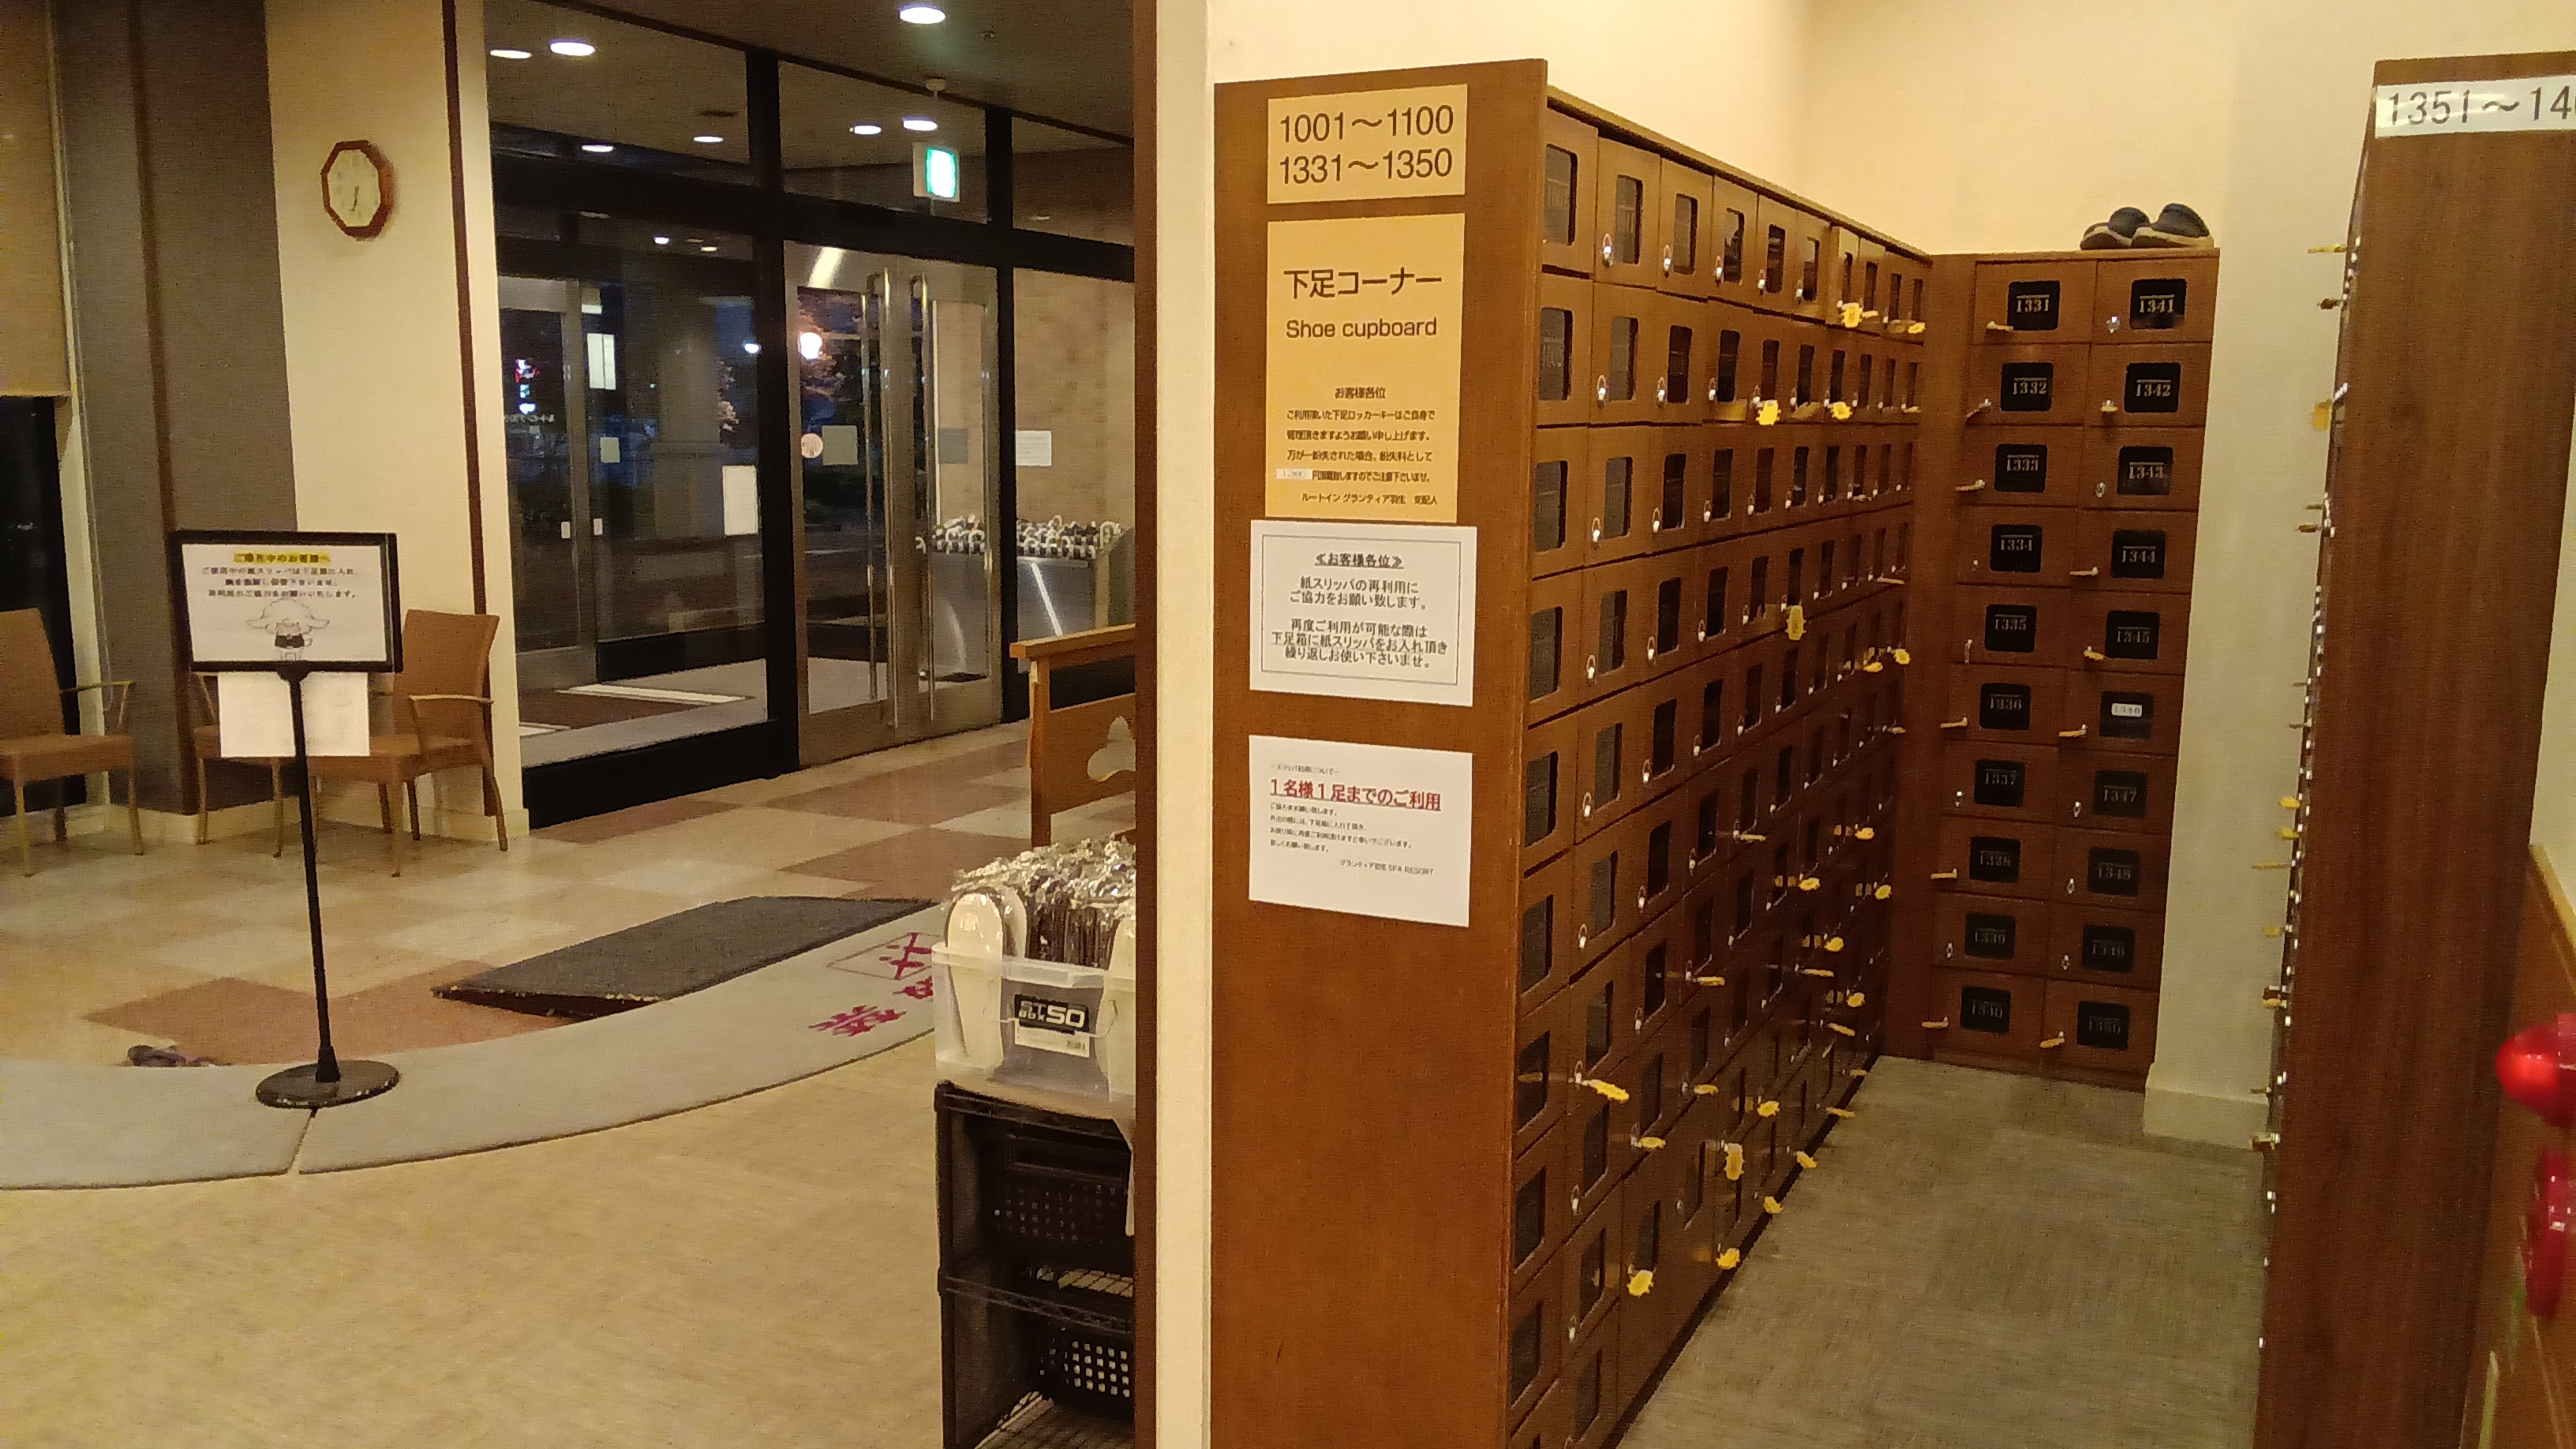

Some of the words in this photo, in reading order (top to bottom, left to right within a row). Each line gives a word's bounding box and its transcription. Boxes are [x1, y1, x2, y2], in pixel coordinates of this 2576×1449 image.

[2389, 85, 2576, 125] 1351～14
[1279, 104, 1454, 143] 1001～1100
[1279, 148, 1452, 185] 1331～1350
[1283, 266, 1443, 299] 下足コーナー
[2016, 298, 2050, 313] 1331
[2139, 298, 2175, 313] 1341
[1286, 319, 1336, 338] Shoe
[1342, 316, 1437, 339] cupboard
[1335, 386, 1386, 399] お客様各位
[2012, 380, 2047, 395] 1332
[2136, 384, 2171, 397] 1342
[1300, 575, 1419, 594] 紙スリッパの再利用に
[1290, 590, 1426, 610] ご協力をお願い致します。
[1291, 619, 1428, 638] 再度ご利用が可能な際は
[1271, 631, 1448, 655] 下足箱に紙スリッパをお入れ頂き
[1285, 647, 1430, 668] 繰り返しお使い下さいませ。
